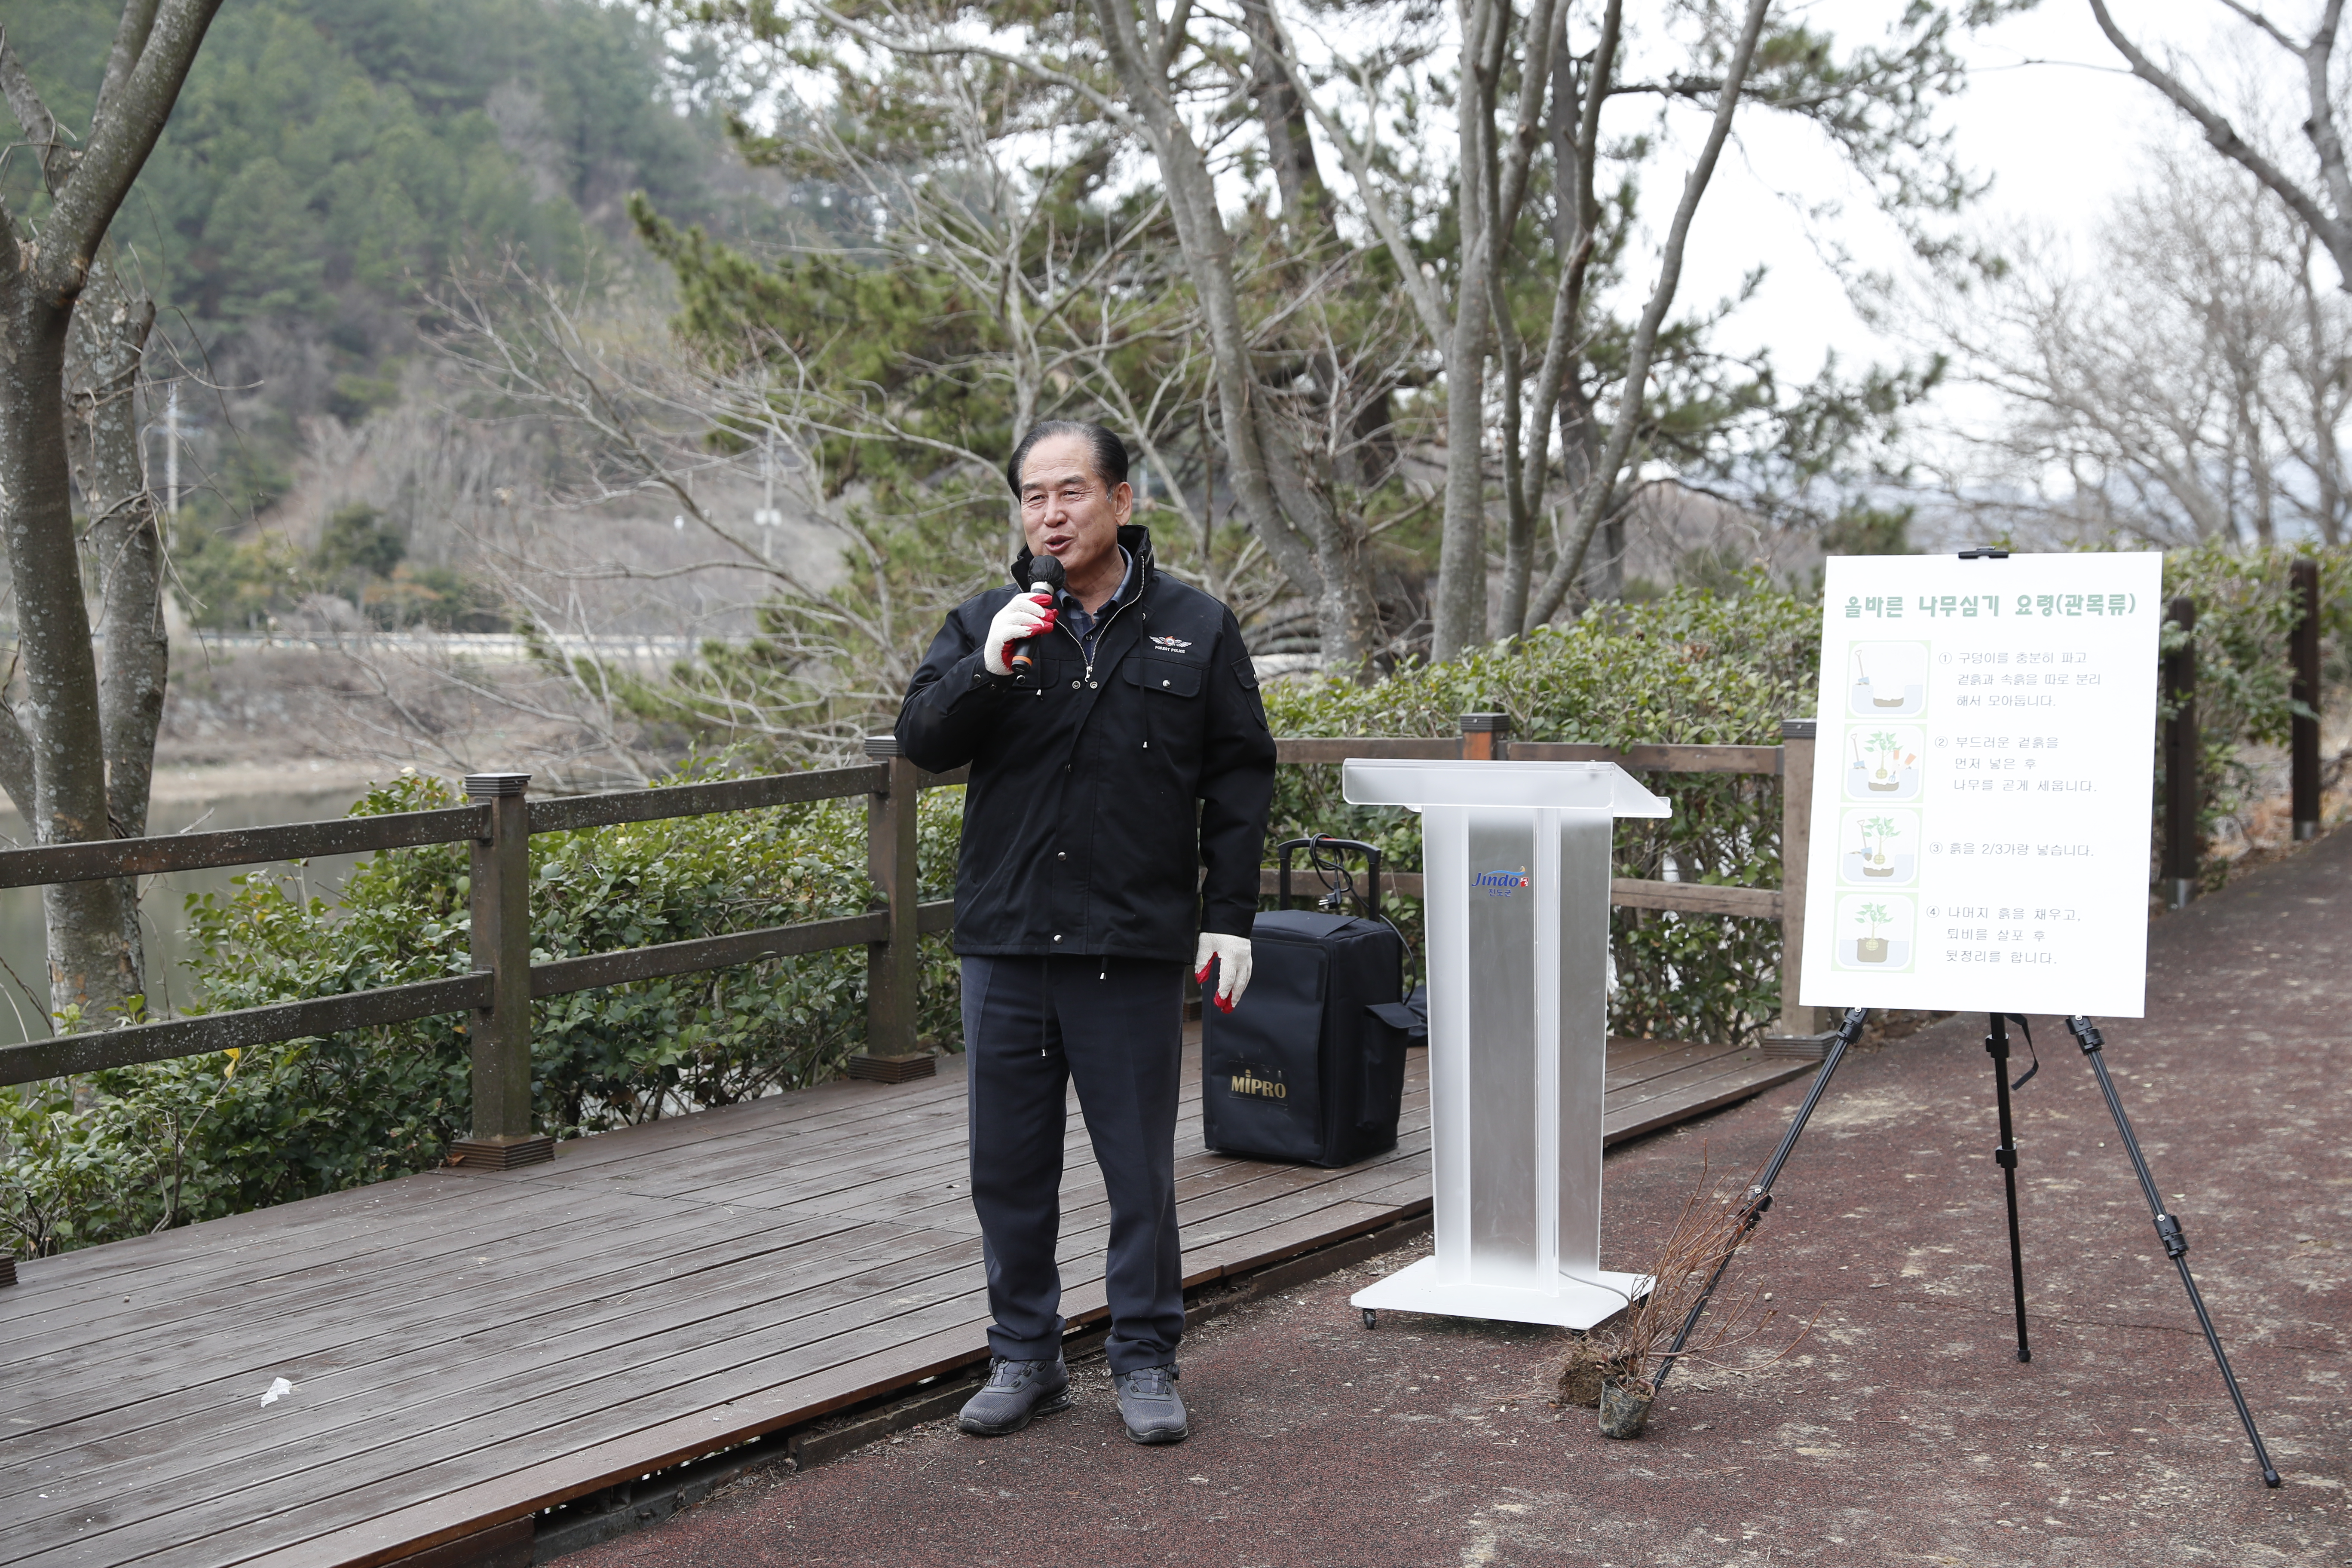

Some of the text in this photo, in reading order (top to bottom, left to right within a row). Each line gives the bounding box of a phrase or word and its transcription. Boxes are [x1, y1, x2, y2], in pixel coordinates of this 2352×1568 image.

[1844, 593, 2136, 618] 올바른 나무심기 요령(관목류)
[1959, 652, 2009, 664] 구덩이를
[2016, 652, 2053, 664] 충분히
[2061, 652, 2086, 663] 파고
[1958, 674, 2100, 685] 겉흙과 속흙을 따로 분리
[1957, 695, 2055, 707] 해서 모아둡니다.
[1956, 737, 2009, 748] 부드러운
[2018, 737, 2058, 748] 겉흙을
[1955, 758, 2036, 770] 먼저 넣은 후
[1954, 779, 2097, 792] 나무를 곧게 세웁니다.
[1950, 842, 1975, 854] 흙을
[1982, 843, 2029, 855] 2/3가량
[2037, 844, 2094, 856] 넣습니다.
[1472, 873, 1519, 887] Jindo
[1949, 906, 1988, 919] 나머지
[1998, 908, 2025, 919] 흙을
[2034, 909, 2080, 922] 채우고,
[1947, 928, 2046, 942] 퇴비를 살포 후
[1946, 950, 2057, 964] 뒷정리를 합니다.
